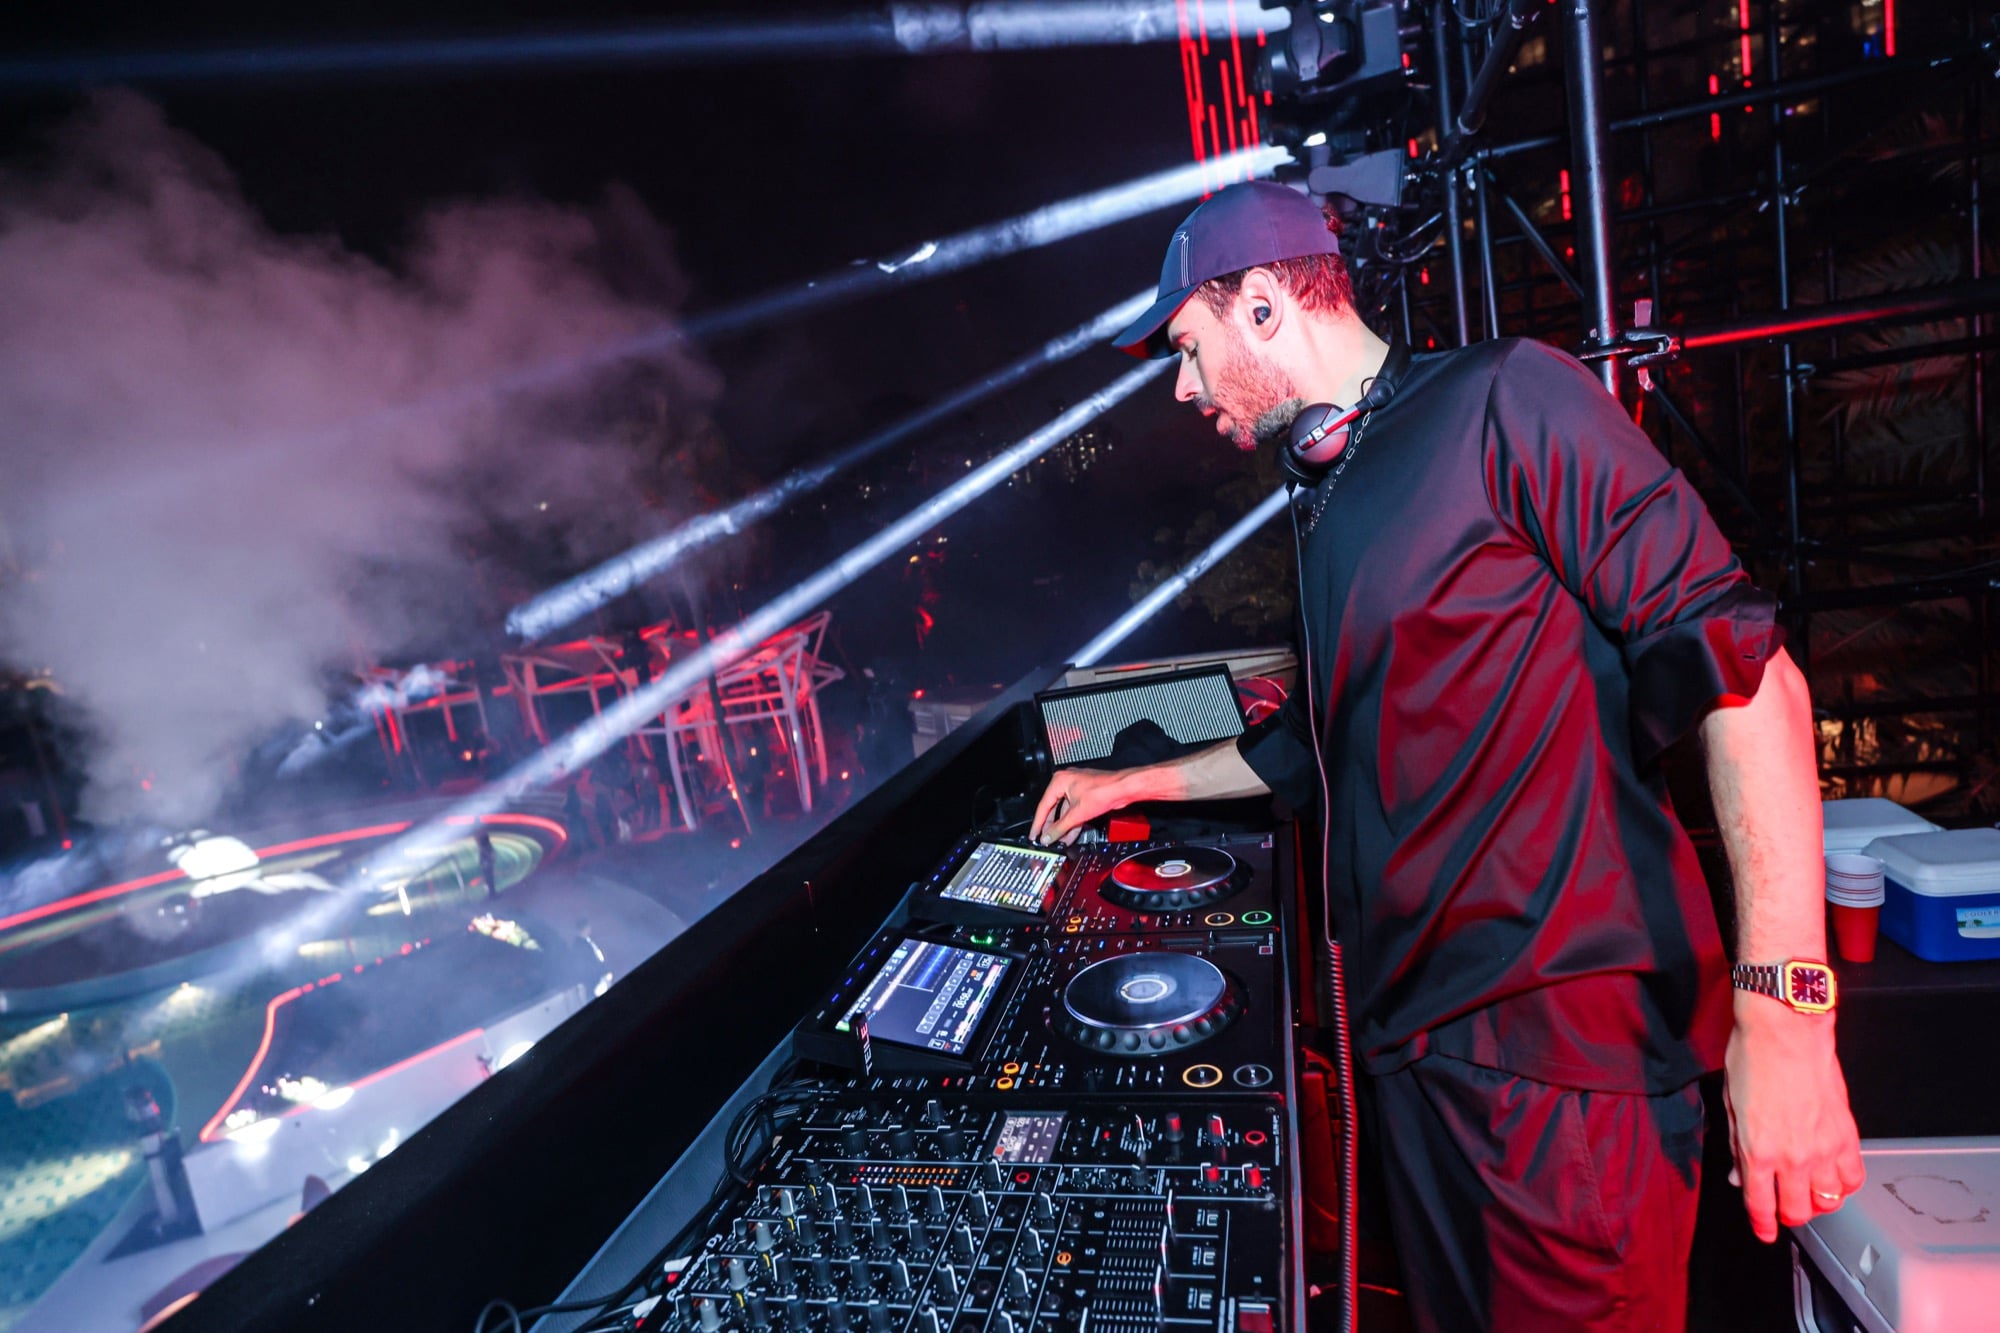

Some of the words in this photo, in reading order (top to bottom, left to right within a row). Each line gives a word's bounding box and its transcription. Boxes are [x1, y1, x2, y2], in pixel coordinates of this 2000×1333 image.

[861, 1022, 873, 1077] TEILE
[1094, 1210, 1105, 1219] 6
[1085, 1248, 1096, 1256] 5
[665, 1248, 708, 1302] Pioneer
